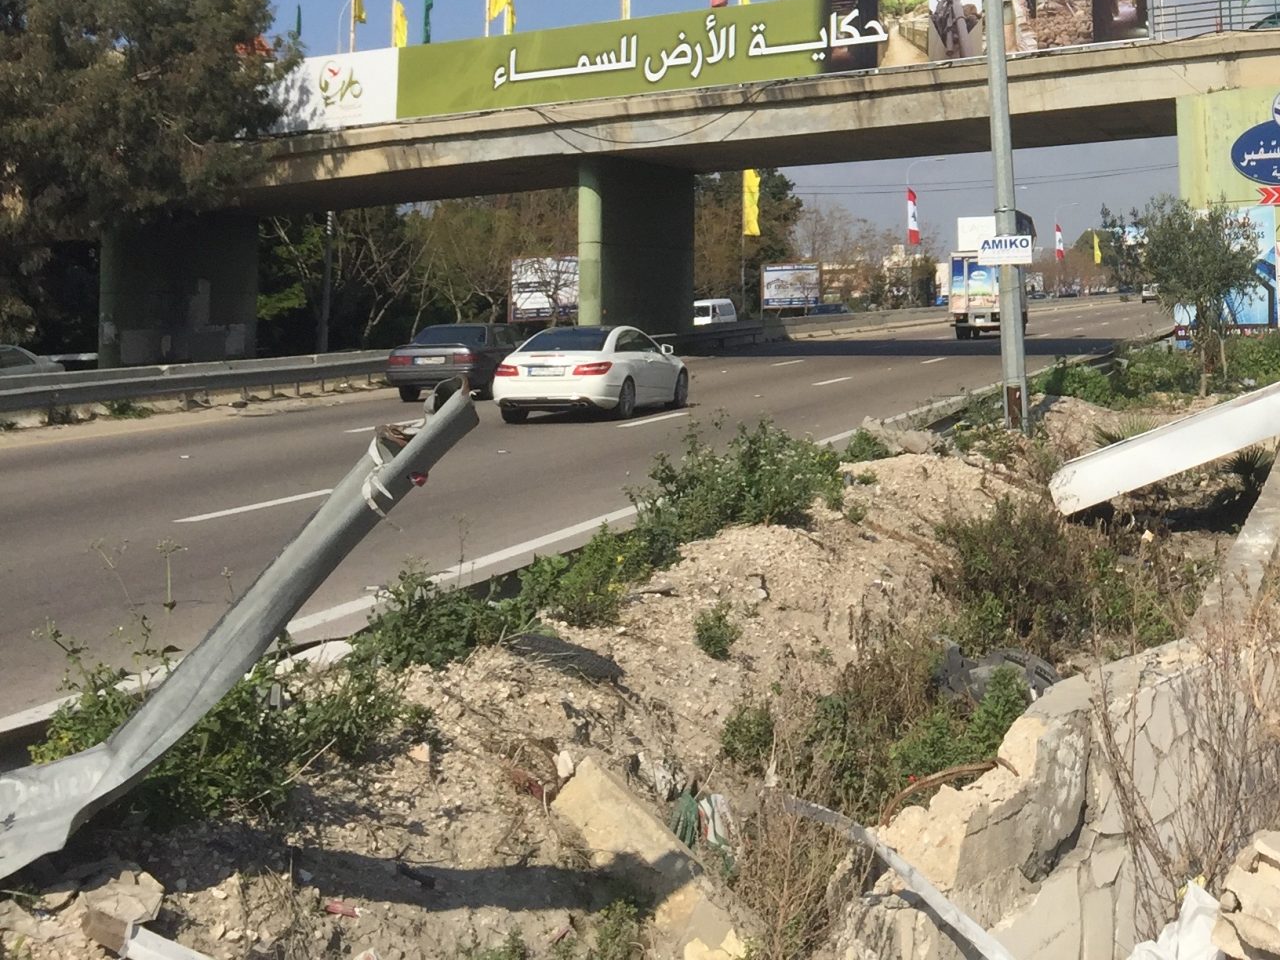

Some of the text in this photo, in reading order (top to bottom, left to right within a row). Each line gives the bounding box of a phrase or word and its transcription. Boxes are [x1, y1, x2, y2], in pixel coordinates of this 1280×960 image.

[493, 9, 889, 89] حكاية الأرض للسماء
[981, 238, 1030, 251] AMIKO
